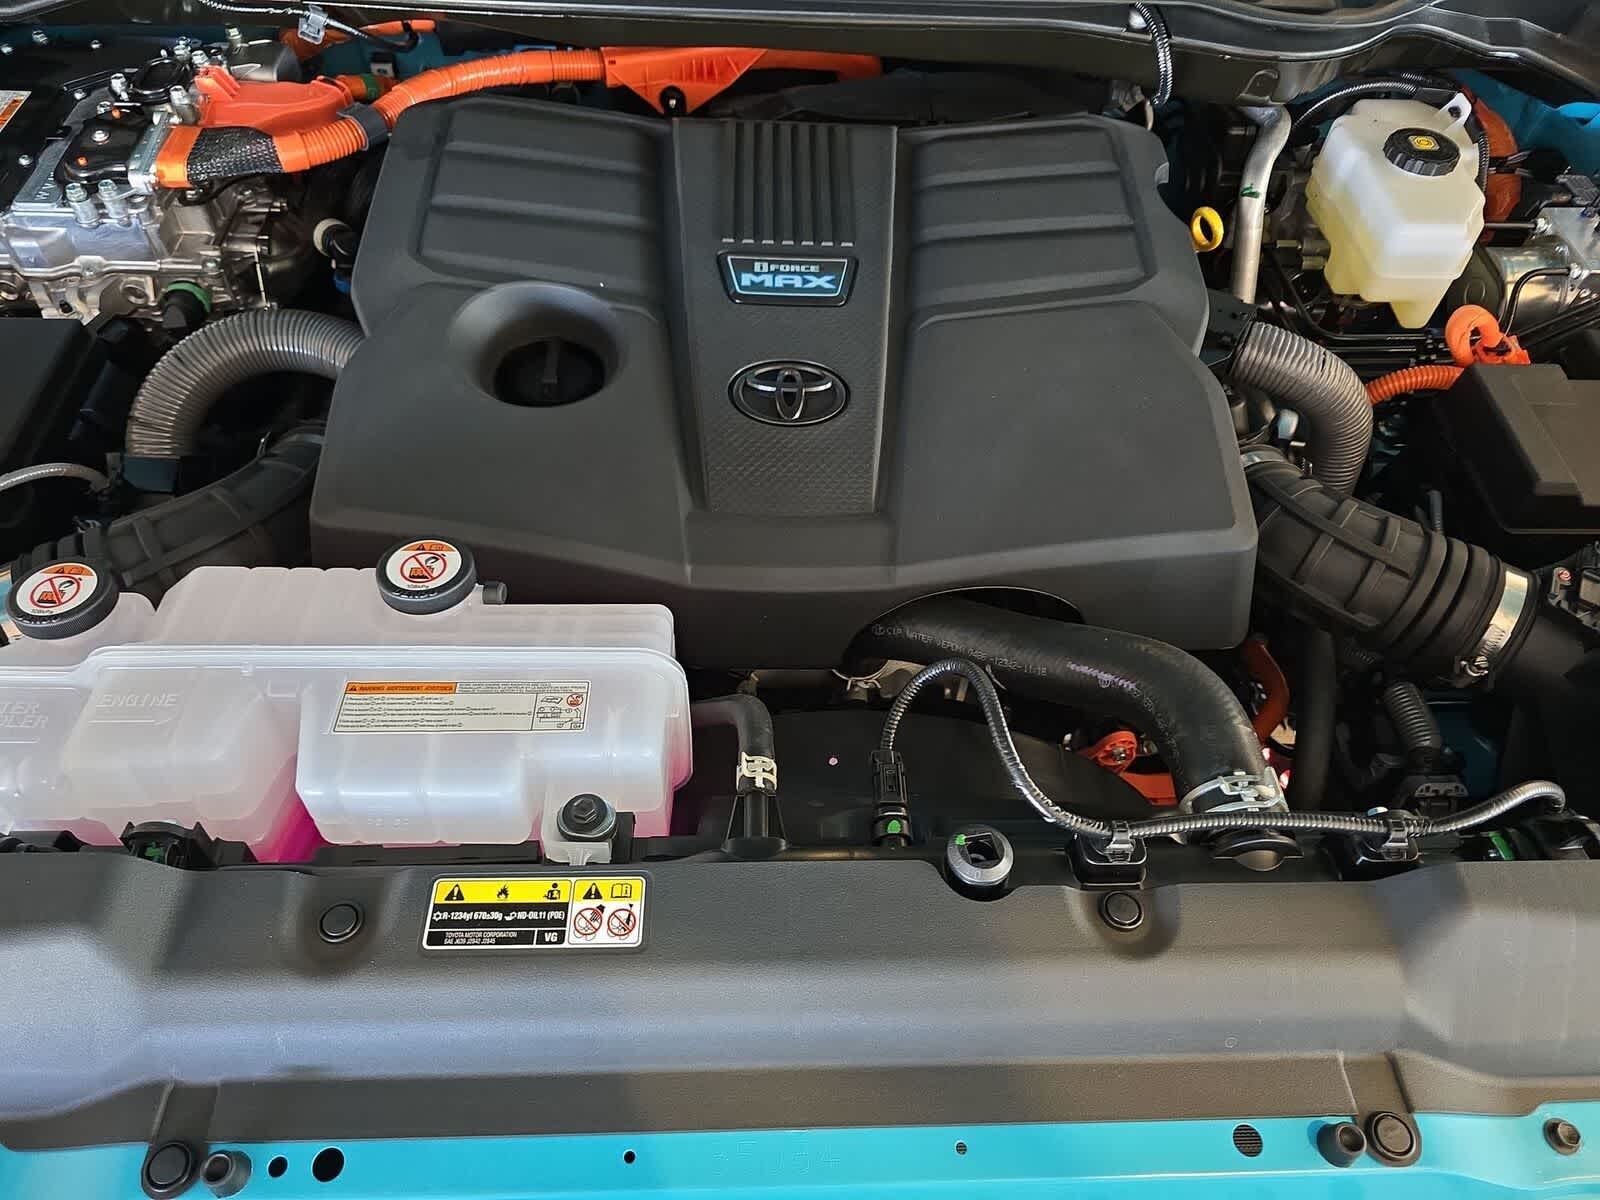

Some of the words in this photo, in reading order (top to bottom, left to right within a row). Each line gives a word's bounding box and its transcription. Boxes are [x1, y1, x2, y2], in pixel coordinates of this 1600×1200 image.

[741, 272, 836, 288] MAX
[98, 693, 179, 706] ENGINE
[547, 911, 565, 920] (POE)
[544, 932, 558, 942] VG
